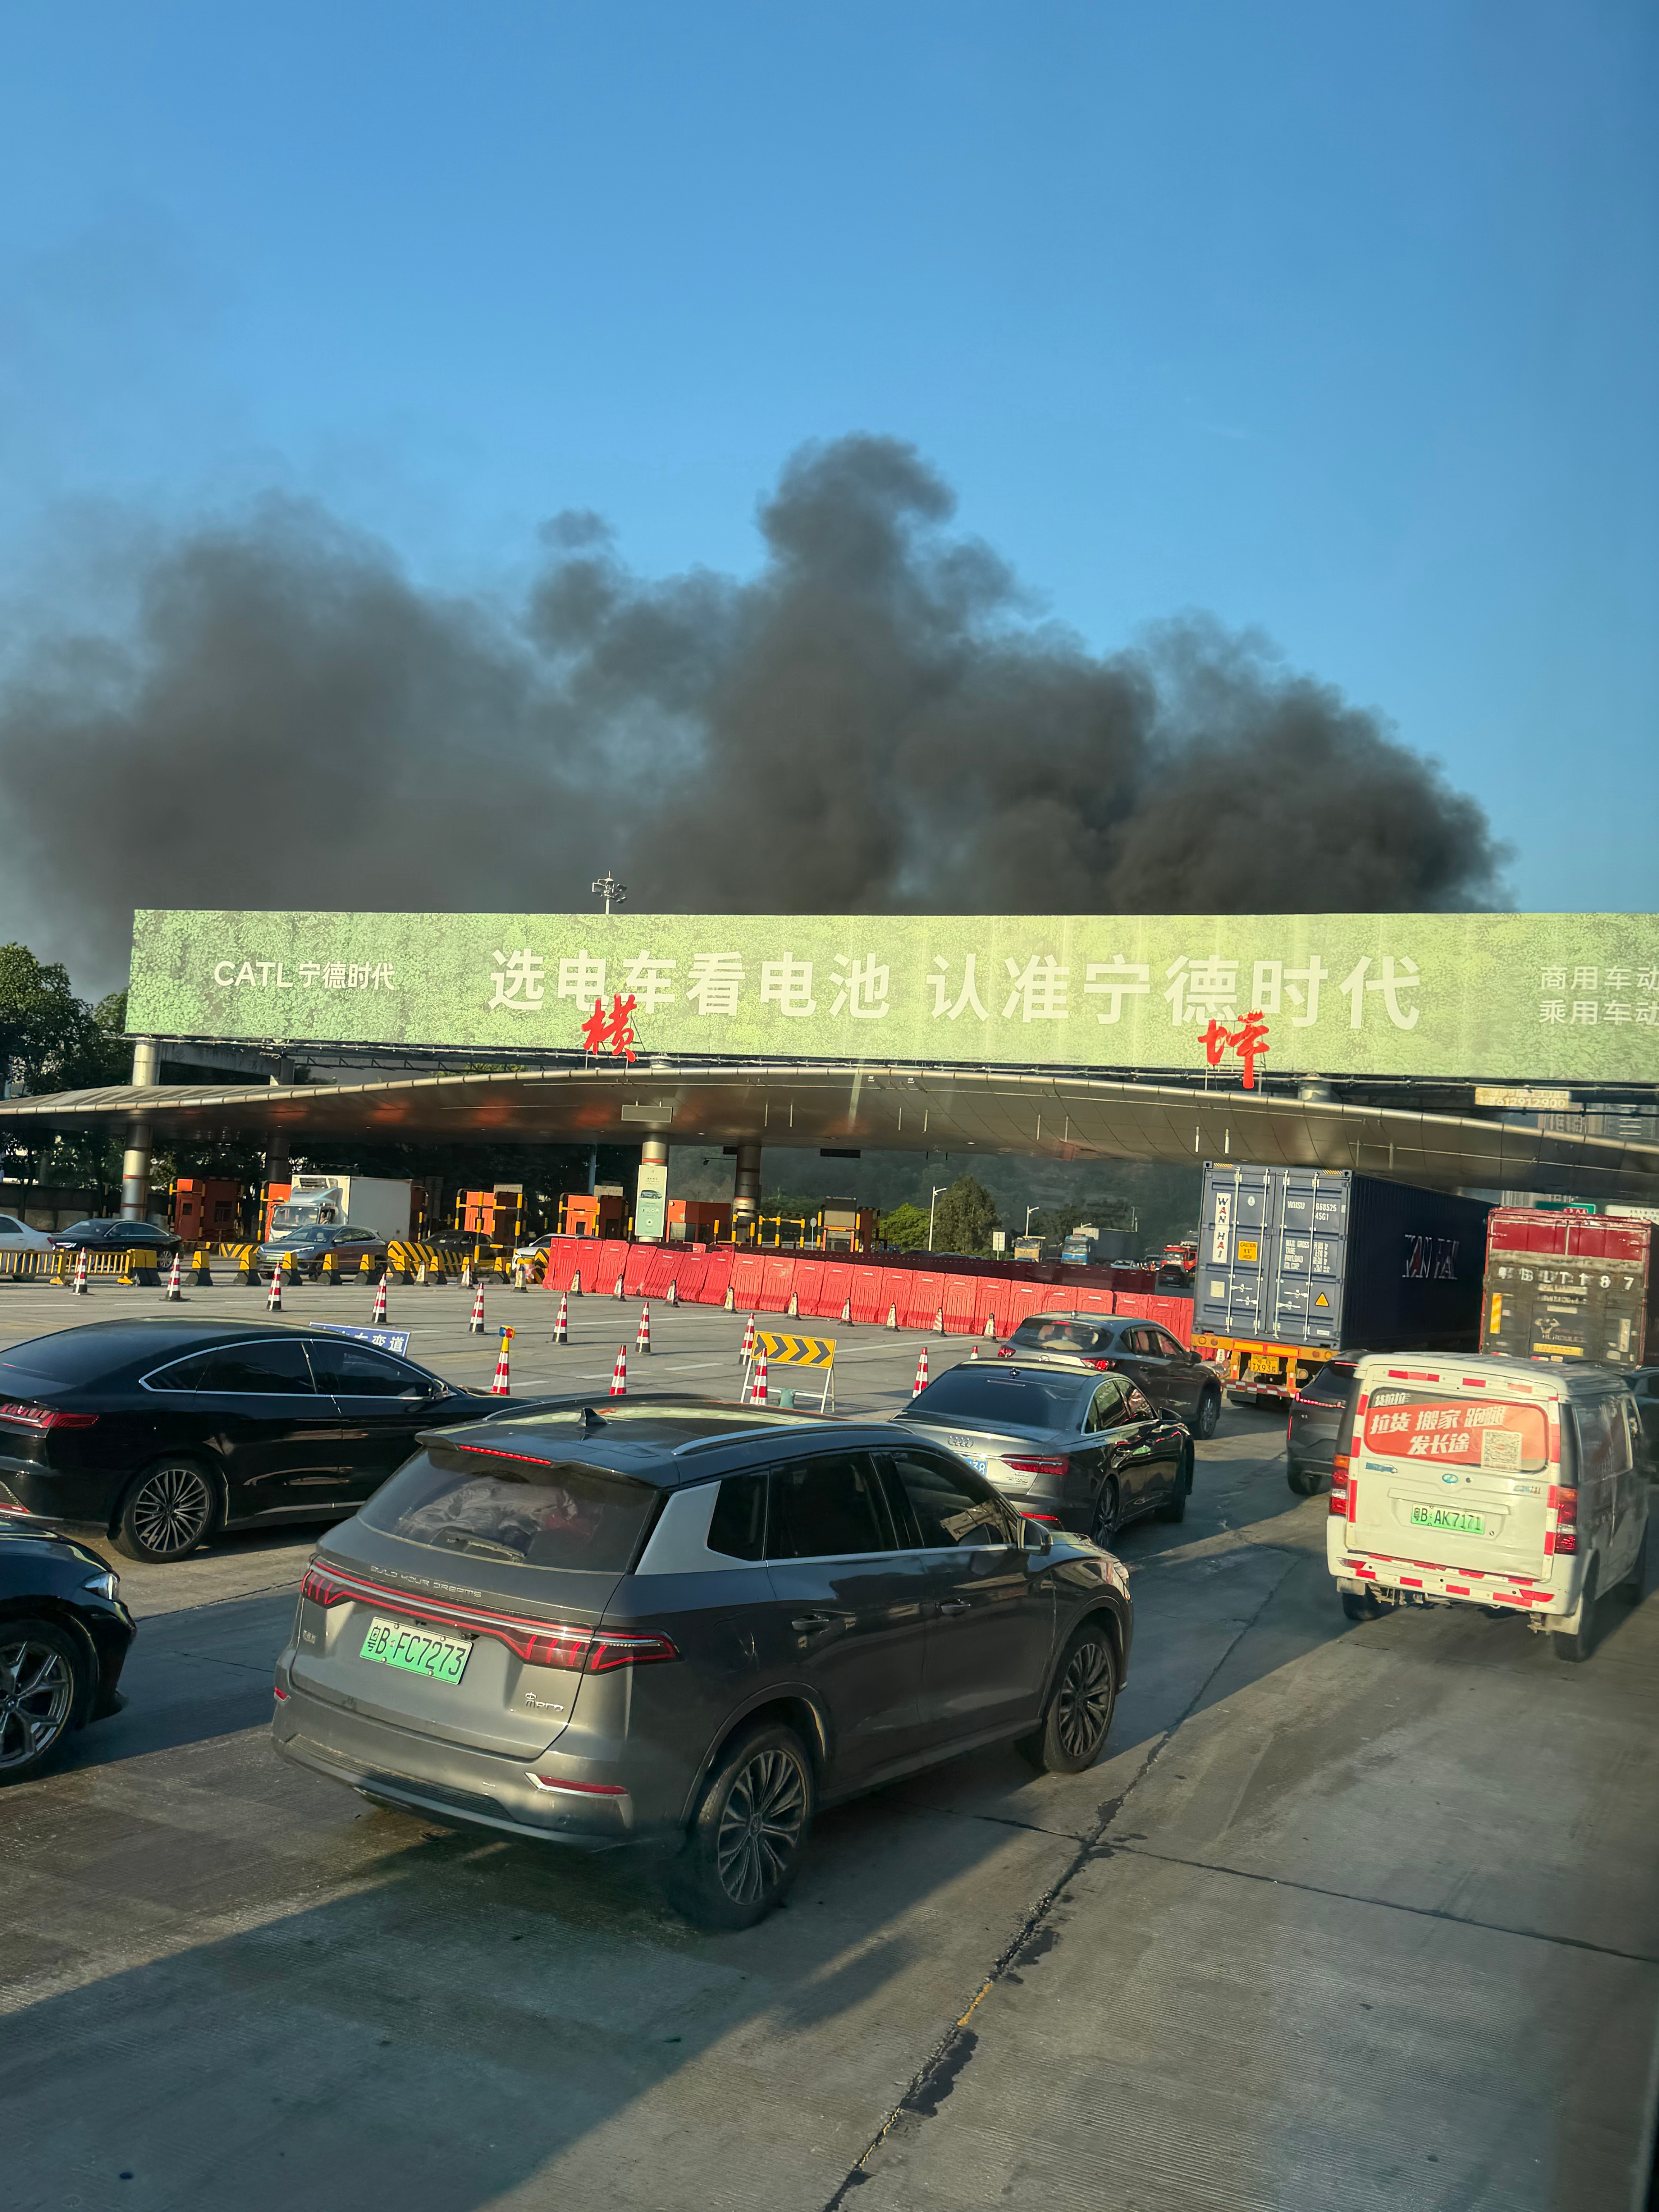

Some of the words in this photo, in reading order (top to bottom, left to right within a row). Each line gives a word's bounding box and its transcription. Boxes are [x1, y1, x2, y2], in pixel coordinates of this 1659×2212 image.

[214, 960, 293, 988] CATL
[298, 960, 395, 991] 宁德时代
[488, 948, 890, 1019] 选电车看电池
[926, 953, 1420, 1030] 认准宁德时代
[1218, 1197, 1229, 1223] WAN
[1217, 1232, 1225, 1258] HAI
[1370, 1412, 1412, 1435] 拉货
[1415, 1409, 1462, 1431] 搬家
[1407, 1433, 1470, 1455] 发长途
